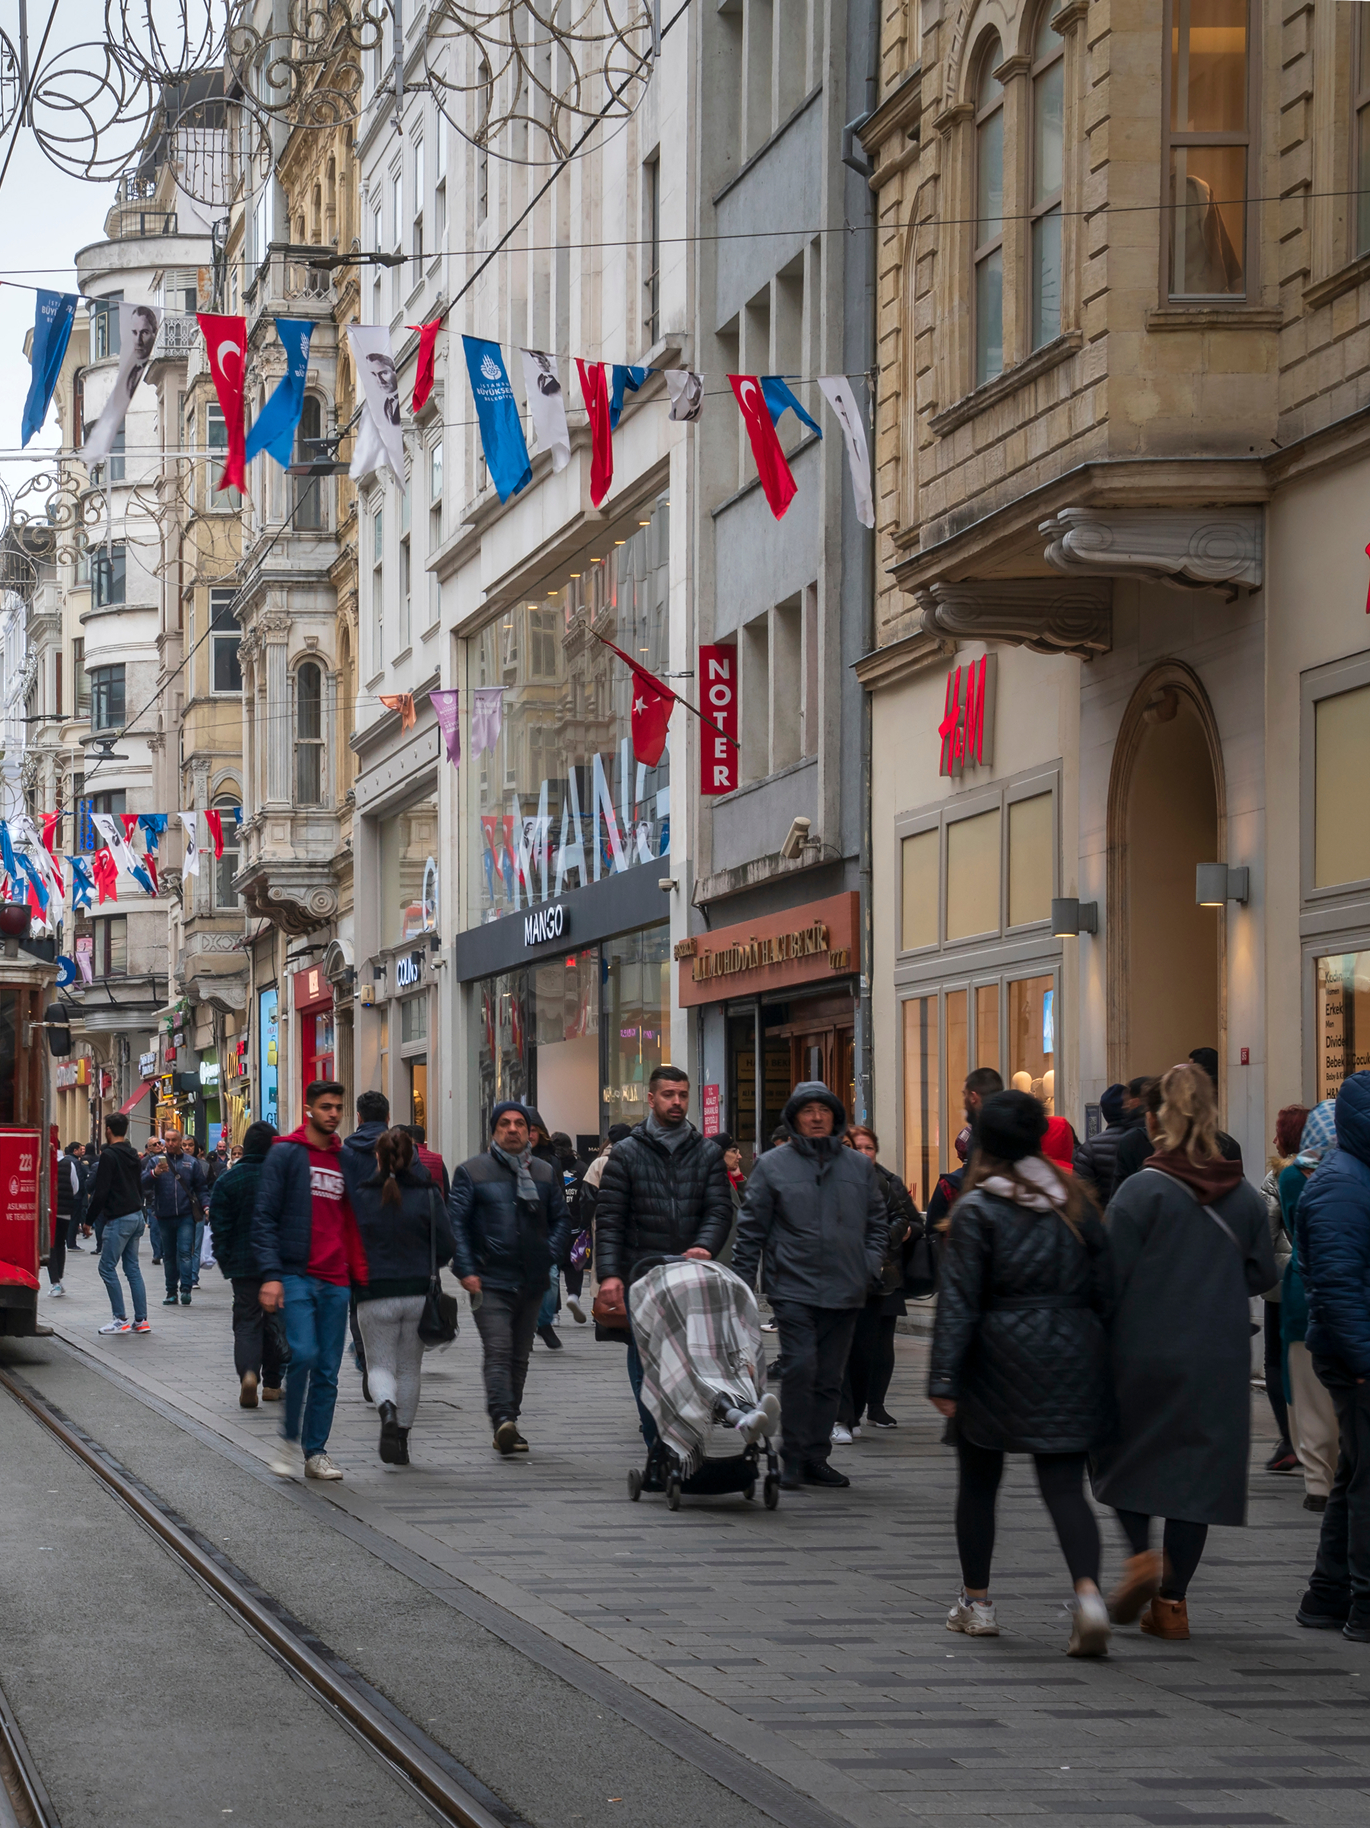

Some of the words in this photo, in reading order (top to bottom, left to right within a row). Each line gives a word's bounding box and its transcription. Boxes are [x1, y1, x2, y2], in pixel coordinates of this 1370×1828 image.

[708, 658, 732, 787] NOTER
[938, 653, 987, 777] H&M
[524, 904, 564, 947] MANGO
[396, 957, 418, 987] COLINS
[19, 1153, 33, 1172] 223
[310, 1170, 345, 1195] ANS
